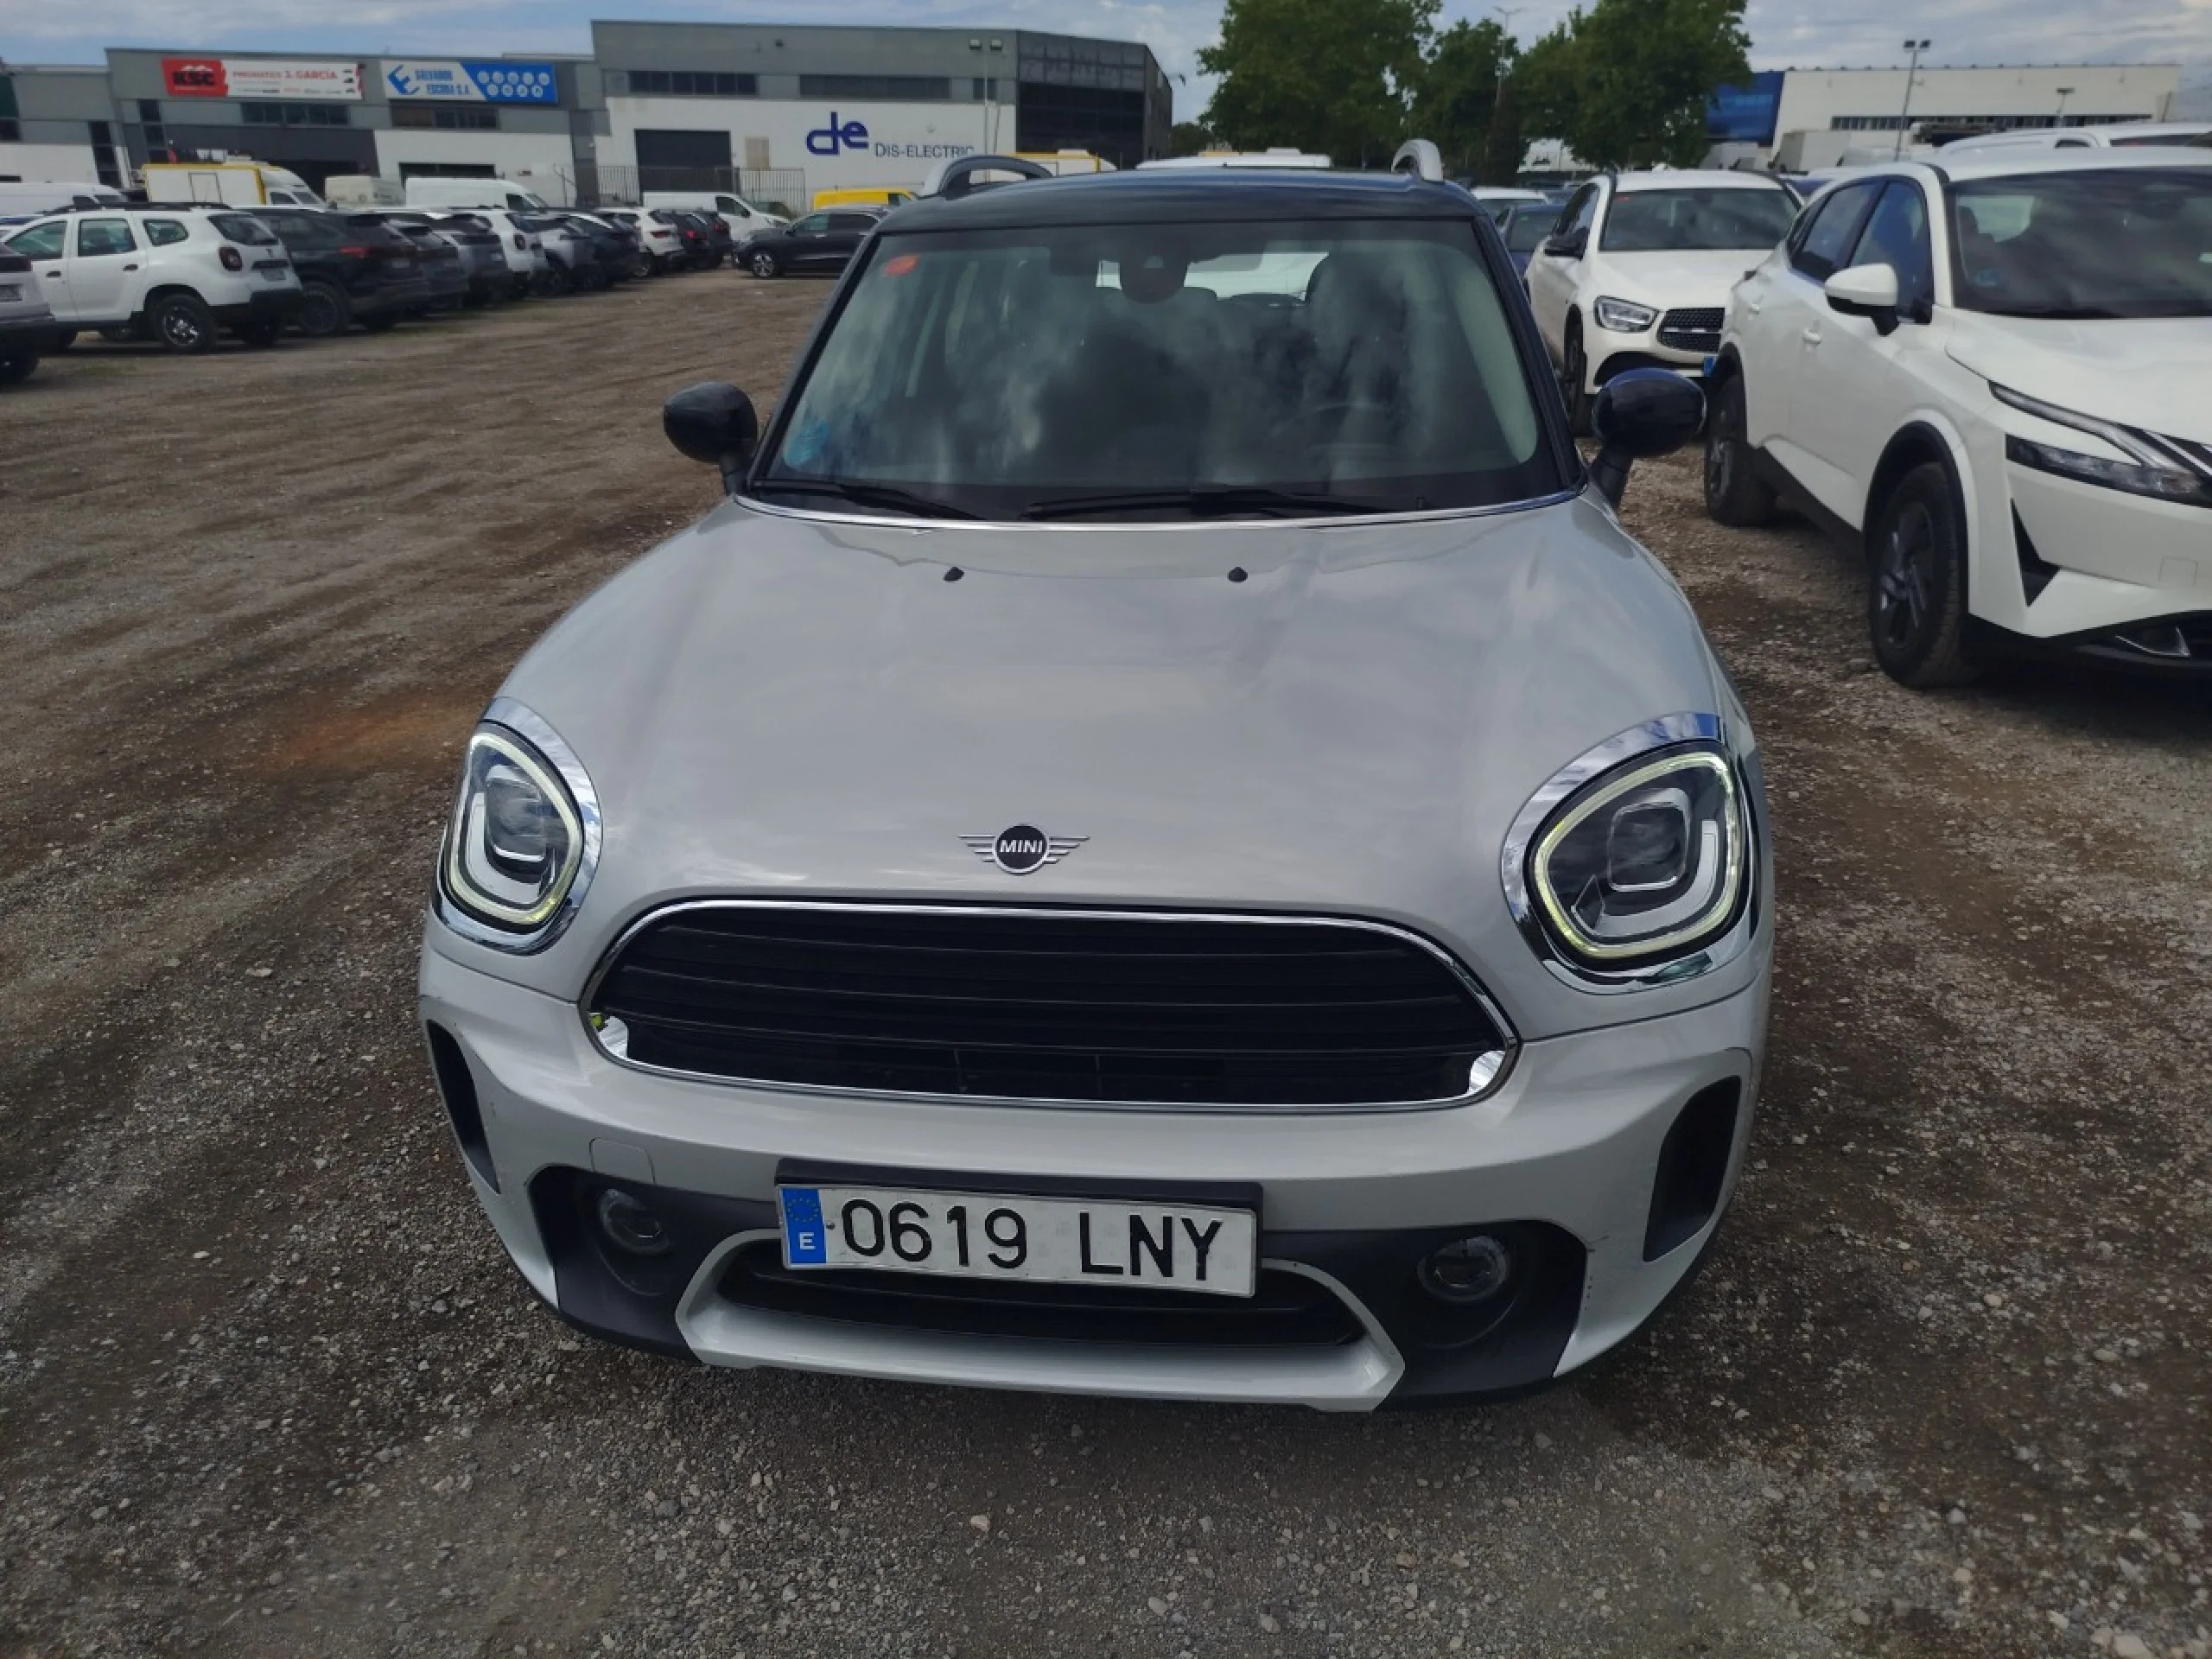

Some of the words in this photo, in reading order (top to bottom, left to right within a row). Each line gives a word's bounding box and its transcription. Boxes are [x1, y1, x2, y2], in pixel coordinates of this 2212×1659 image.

[999, 839, 1043, 853] MINI
[798, 1232, 815, 1250] E
[841, 1198, 1027, 1269] 0619
[1079, 1211, 1224, 1281] LNY
